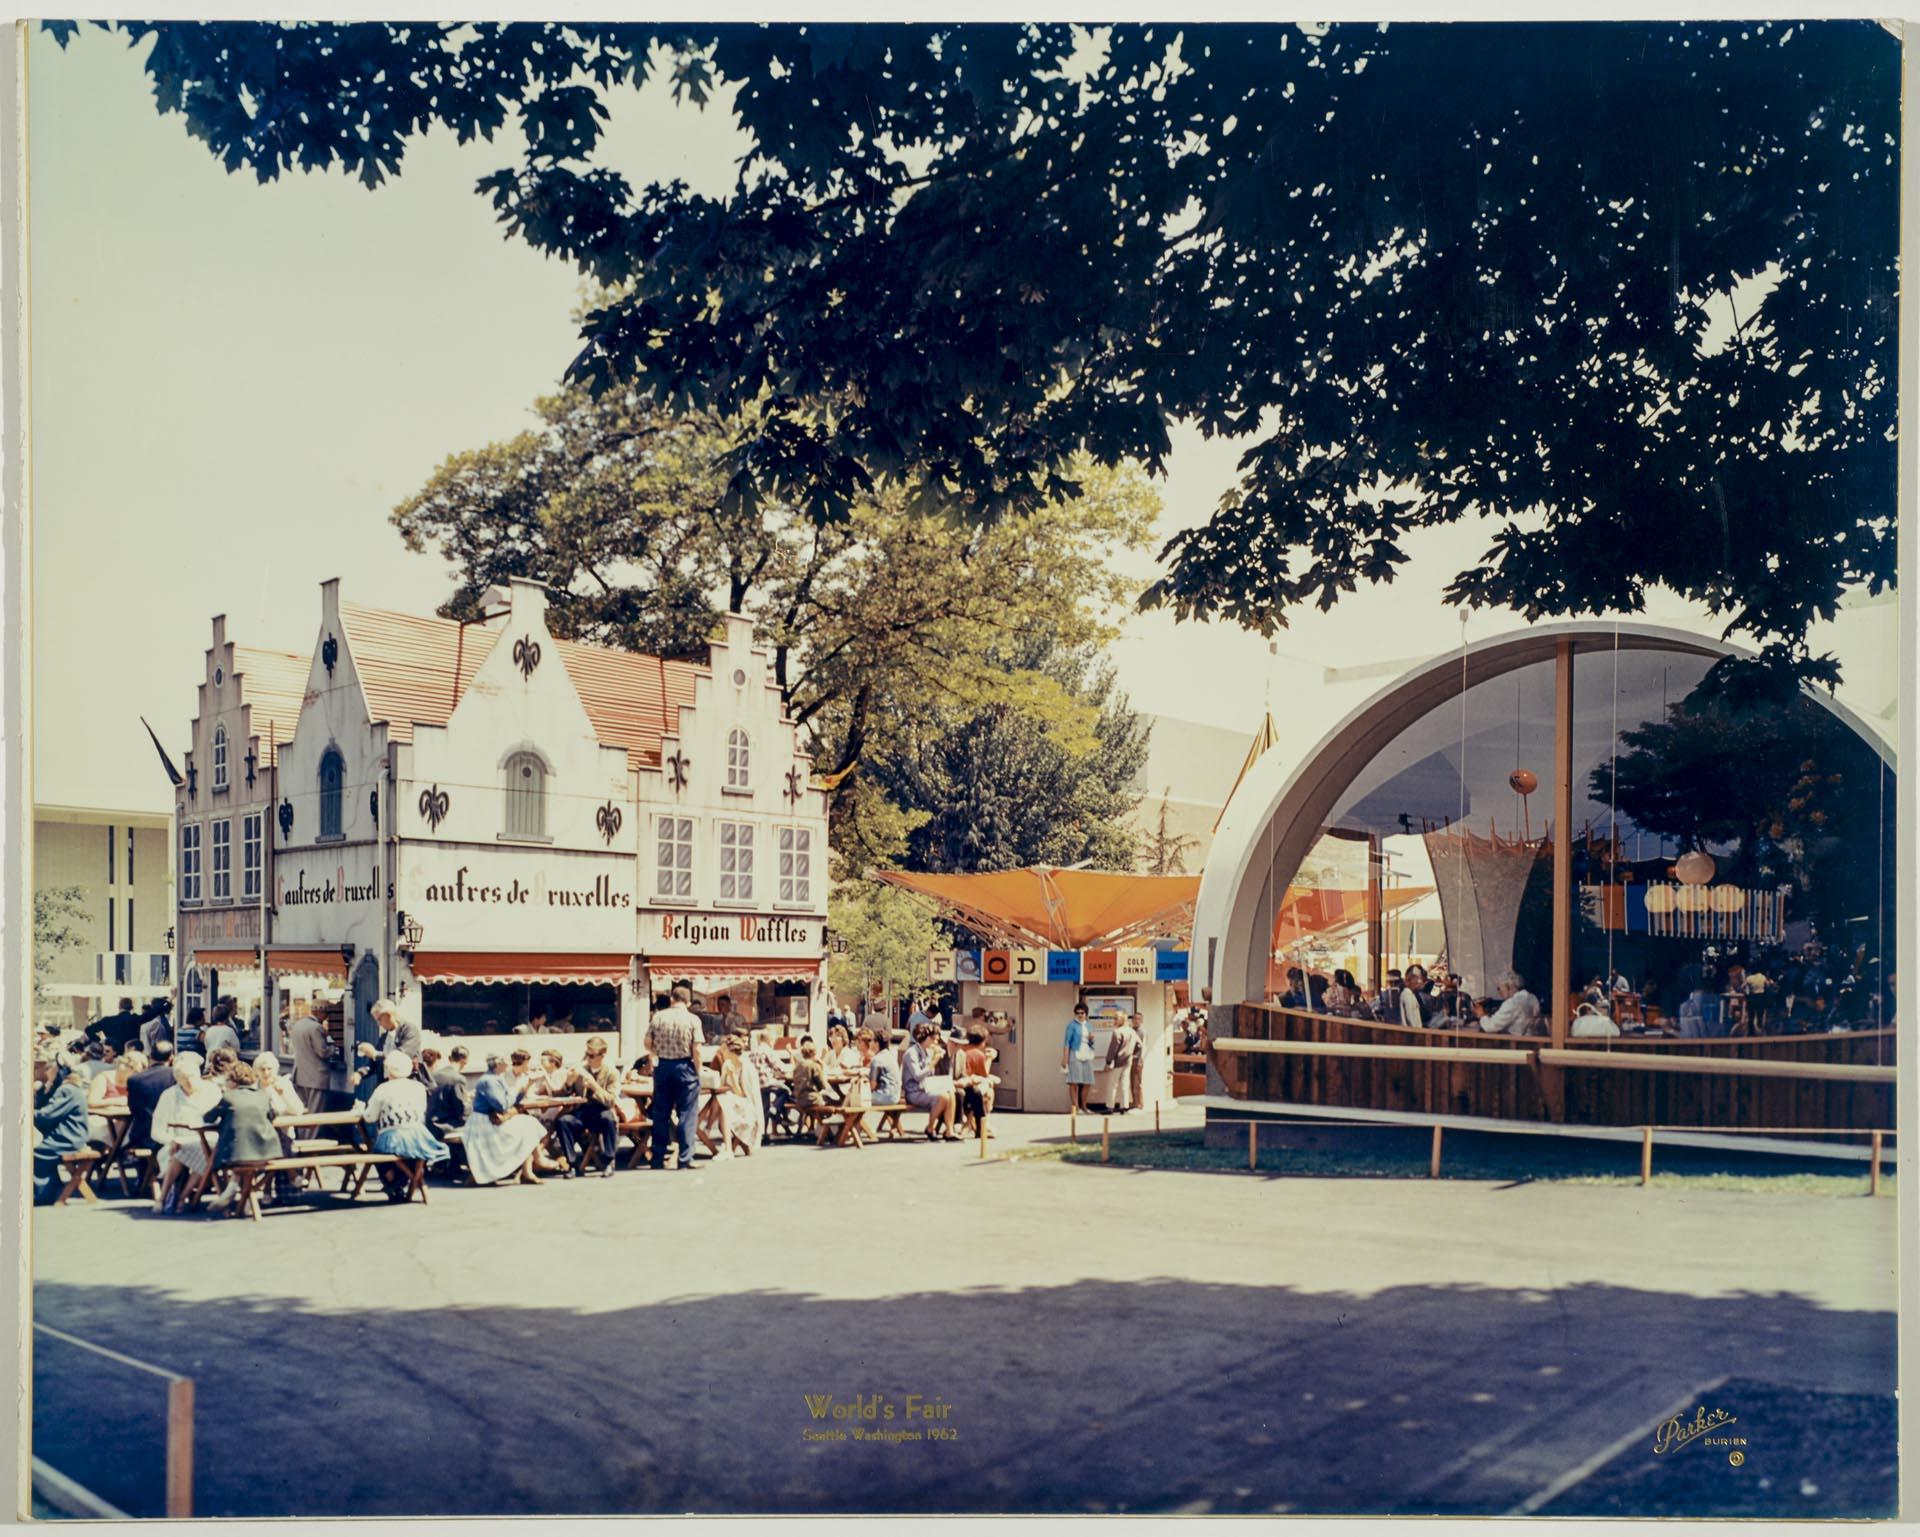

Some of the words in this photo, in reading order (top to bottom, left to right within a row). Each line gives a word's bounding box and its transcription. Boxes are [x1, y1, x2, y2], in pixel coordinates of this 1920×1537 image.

[323, 879, 335, 903] de
[507, 878, 529, 904] de
[661, 913, 730, 945] Belgian
[740, 914, 807, 942] Waffles
[933, 957, 1036, 976] FOOD
[1123, 967, 1149, 975] DRINKS
[1127, 958, 1145, 966] COLD
